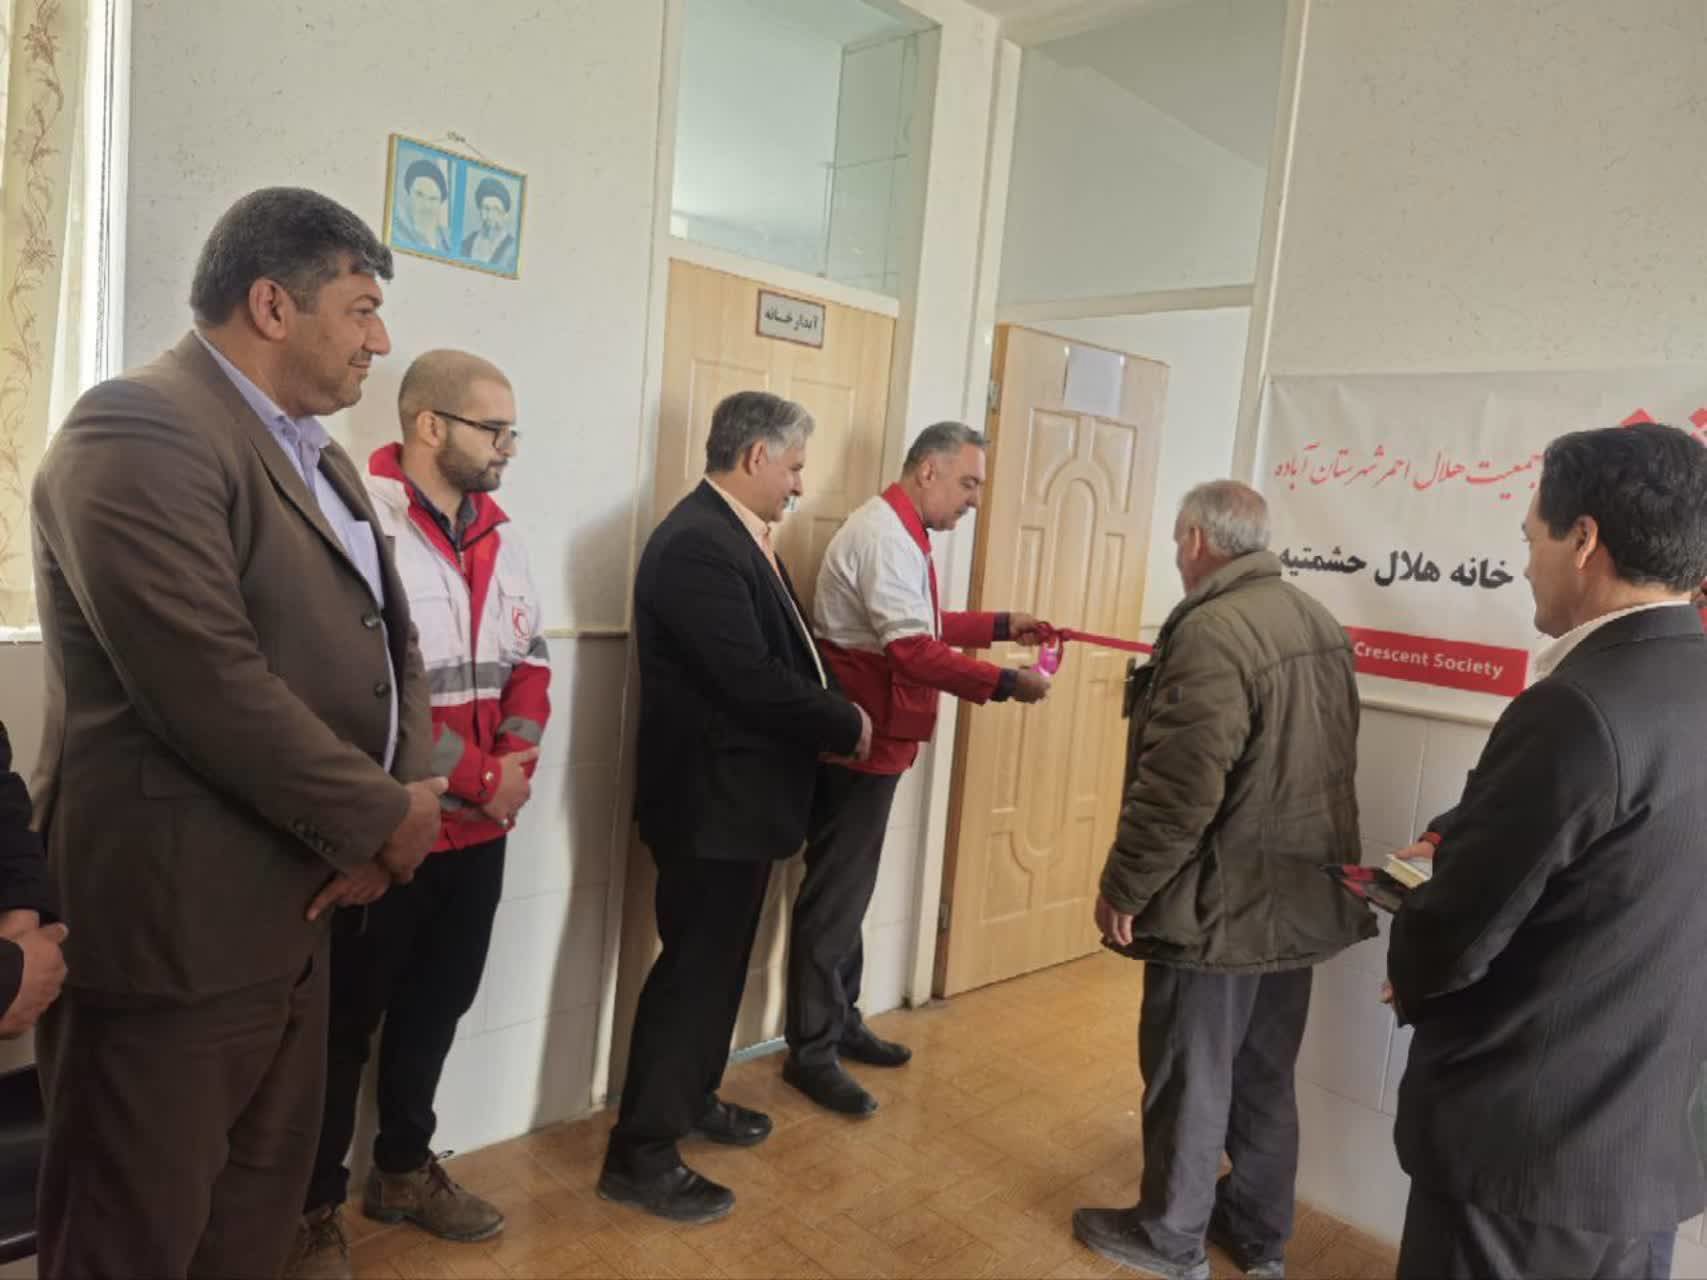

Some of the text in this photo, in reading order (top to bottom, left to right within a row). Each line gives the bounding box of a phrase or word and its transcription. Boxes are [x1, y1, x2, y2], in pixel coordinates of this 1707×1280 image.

[1273, 442, 1320, 491] آباده
[1307, 444, 1384, 486] شهرستان
[1371, 457, 1410, 489] احمر
[1412, 449, 1465, 491] هلال
[1280, 546, 1514, 590] خانه هلال حشمتیه
[1353, 640, 1504, 681] Crescent Society
